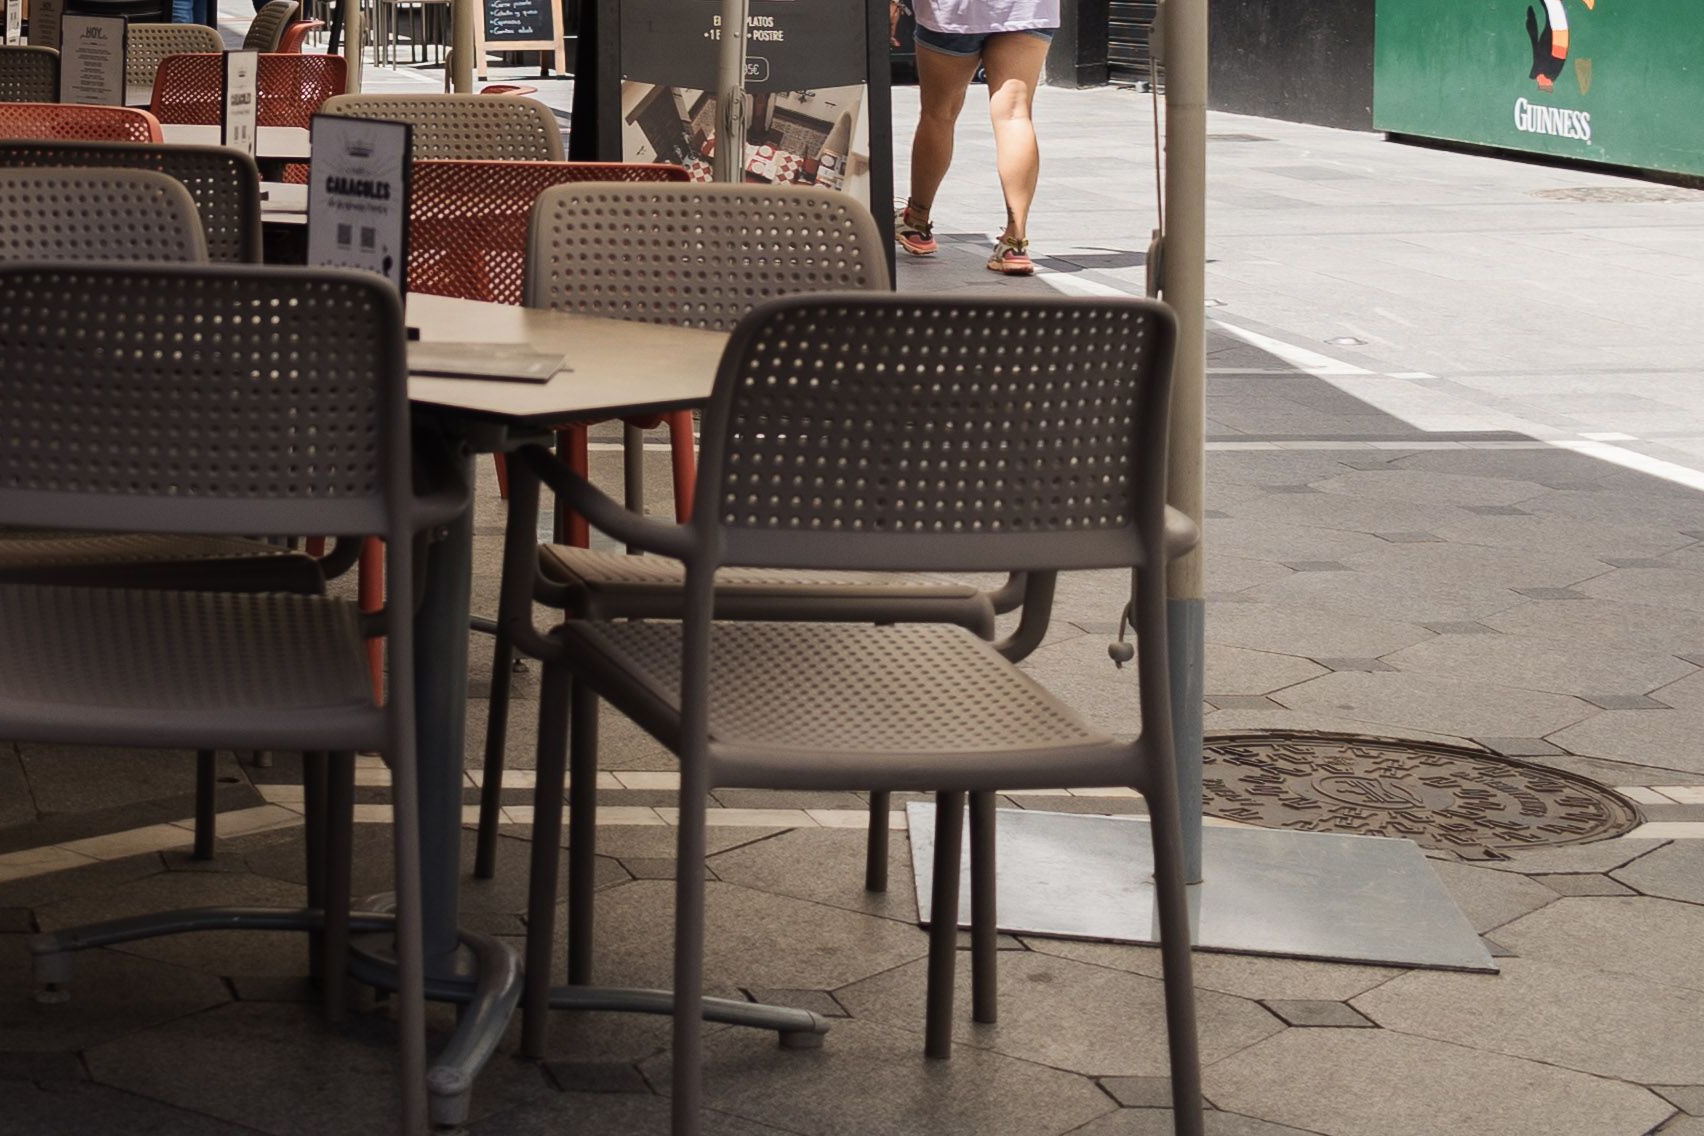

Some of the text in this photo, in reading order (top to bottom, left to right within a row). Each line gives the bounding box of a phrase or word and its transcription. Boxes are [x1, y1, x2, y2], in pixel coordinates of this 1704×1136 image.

[752, 29, 785, 42] POSTRE
[1513, 96, 1592, 141] GUINNESS
[325, 175, 391, 201] CARACOLES
